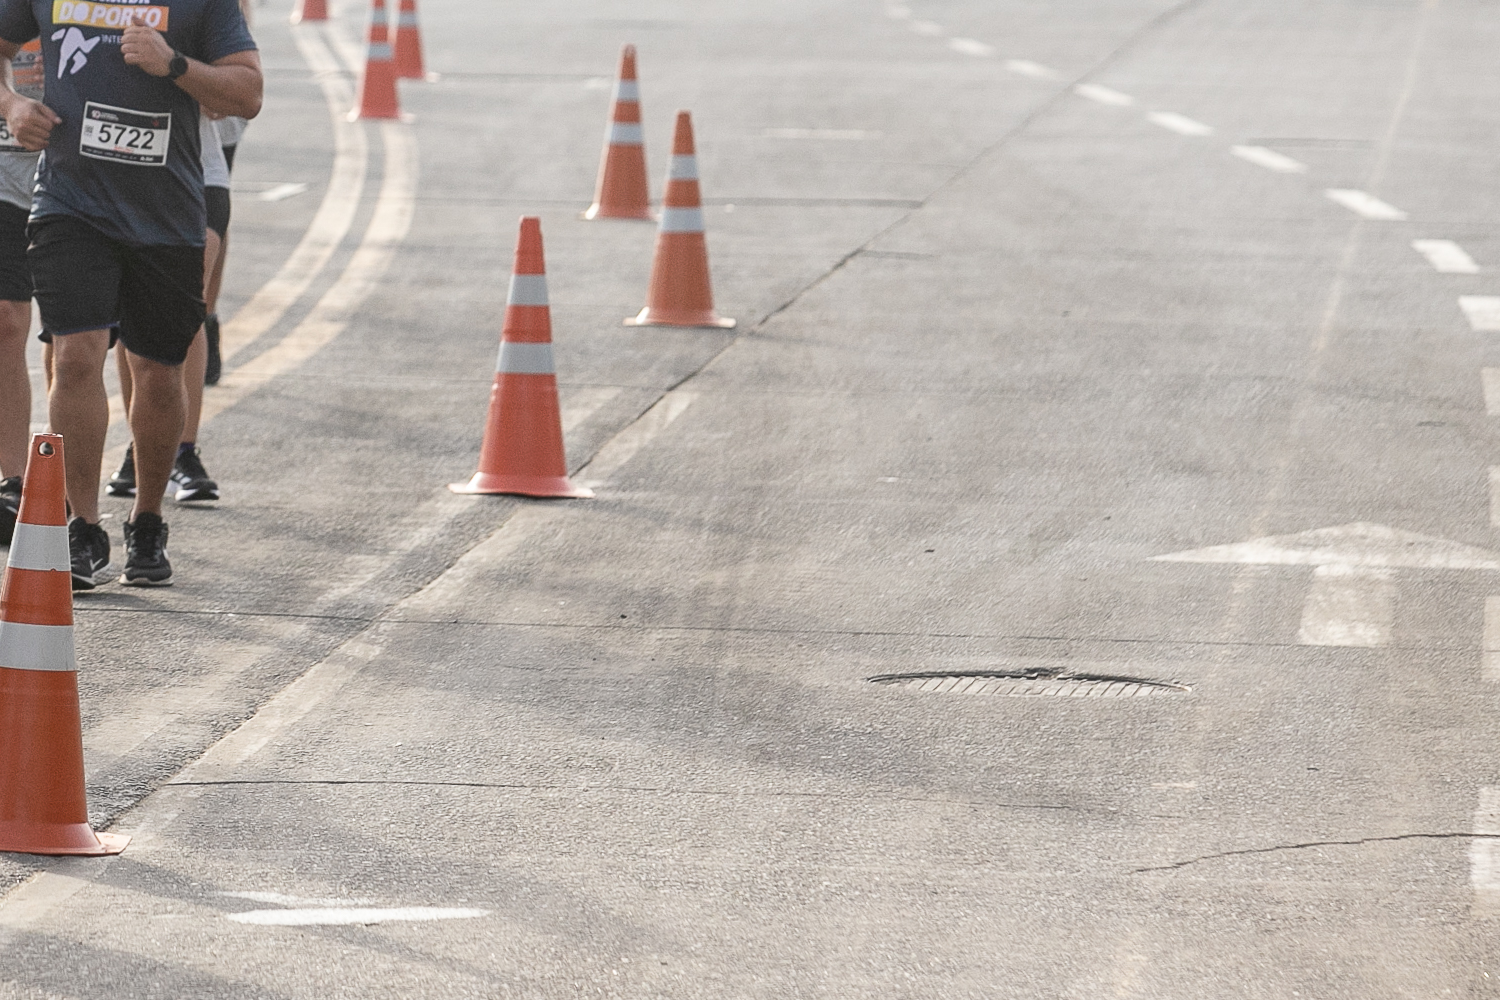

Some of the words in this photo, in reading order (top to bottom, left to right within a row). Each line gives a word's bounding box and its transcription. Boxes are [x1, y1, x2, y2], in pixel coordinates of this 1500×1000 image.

[59, 1, 90, 21] DO
[90, 4, 162, 29] PORTO
[98, 124, 155, 150] 5722
